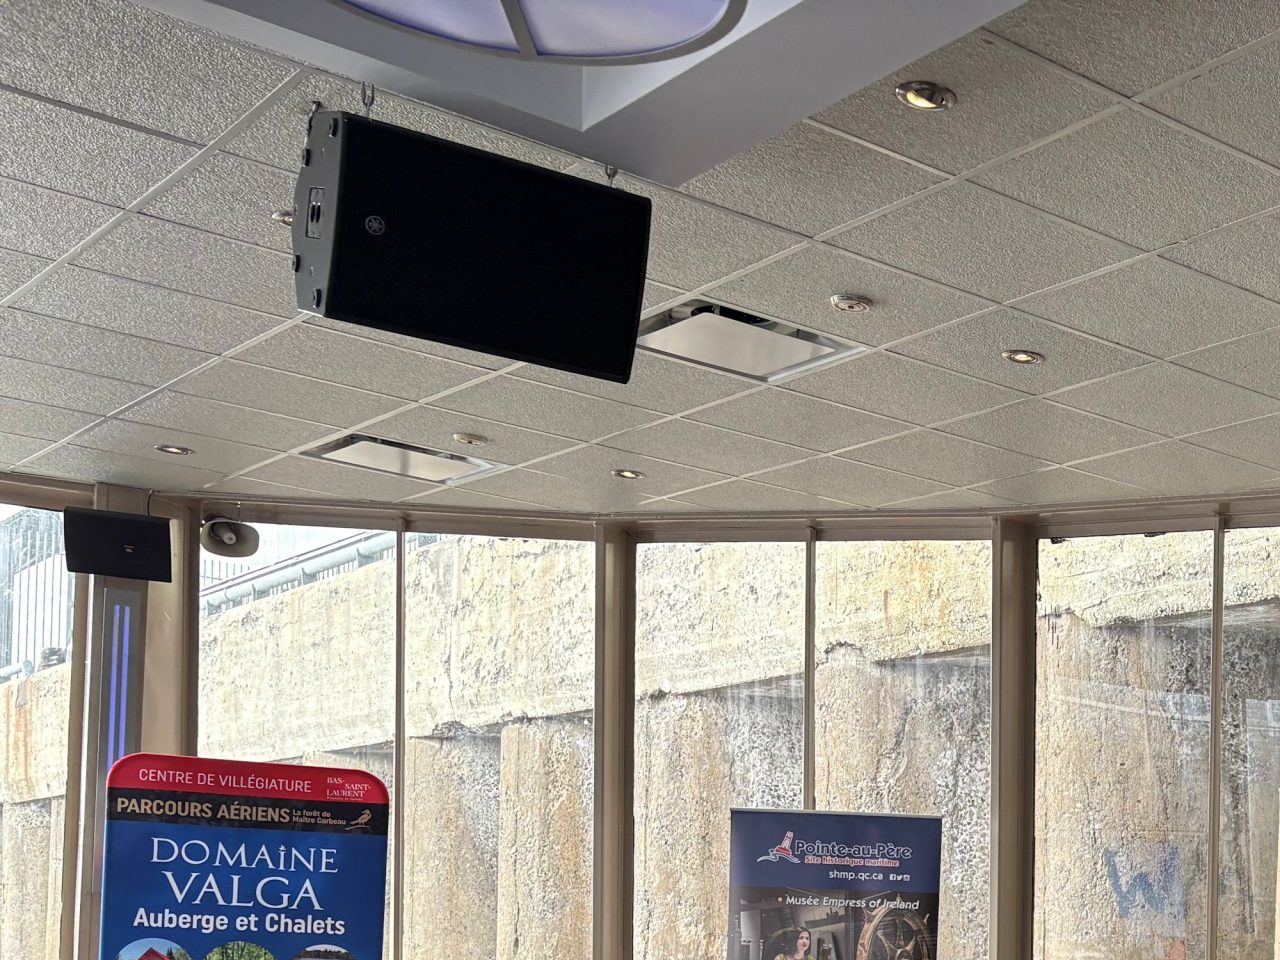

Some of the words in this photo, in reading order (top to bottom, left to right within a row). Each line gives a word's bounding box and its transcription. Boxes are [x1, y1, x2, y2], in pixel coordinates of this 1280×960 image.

[139, 768, 193, 784] CENTRE
[197, 774, 215, 786] DE
[219, 775, 312, 793] VILLÉGIATURE
[345, 783, 371, 791] SAINT-
[327, 789, 365, 797] LAURENT
[116, 797, 212, 818] PARCOURS
[217, 801, 290, 823] AÉRIENS
[317, 817, 346, 825] Corbeau
[795, 840, 912, 859] Pointe-au-Père
[805, 855, 821, 864] Site
[822, 856, 864, 867] historique
[865, 859, 900, 867] maritime
[829, 870, 883, 881] shmp.qc.ca
[162, 871, 324, 911] VALGA
[786, 895, 820, 906] Musée
[822, 897, 866, 908] Empress
[869, 898, 882, 908] of
[883, 900, 920, 910] Ireland
[133, 907, 229, 934] Auberge
[235, 914, 258, 932] et
[265, 912, 346, 935] Chalets
